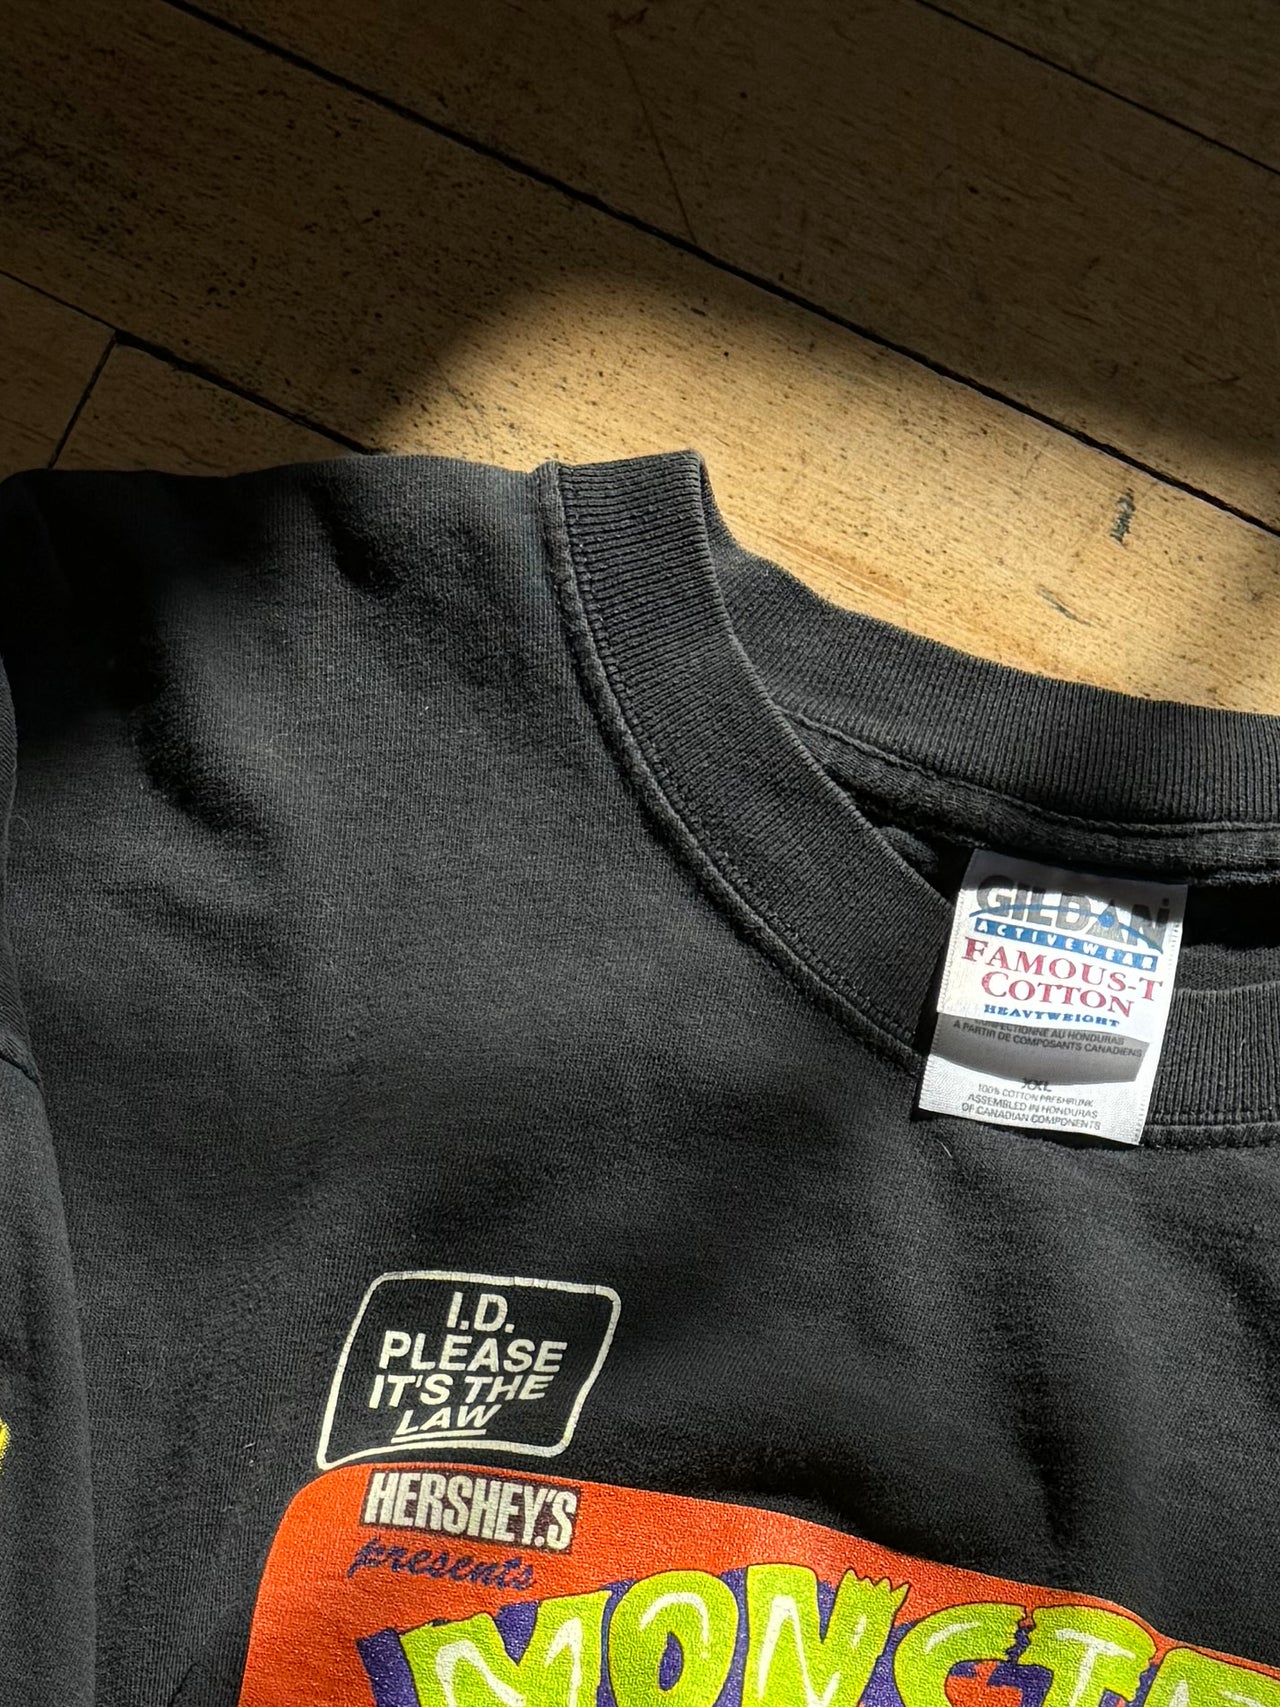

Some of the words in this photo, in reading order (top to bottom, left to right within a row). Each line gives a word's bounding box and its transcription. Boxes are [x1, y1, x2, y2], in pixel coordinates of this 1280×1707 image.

[974, 876, 1170, 953] GILDAN
[976, 920, 1154, 971] ACTIVEWEAR
[962, 936, 1164, 1001] FAMOUS-T
[981, 971, 1134, 1018] COTTON
[983, 1004, 1120, 1027] HEAVYWEIGHT
[998, 1031, 1013, 1044] DE
[1013, 1034, 1083, 1051] COMPOSANTS
[1084, 1043, 1143, 1058] CANADIENS
[969, 1093, 1027, 1111] ASSEMBLED
[1041, 1104, 1099, 1119] HONDURAS
[1001, 1087, 1038, 1102] COTTON
[976, 1105, 1030, 1122] CANADIAN
[1030, 1114, 1102, 1131] COMPONENTS
[446, 1291, 515, 1334] I.D.
[378, 1330, 568, 1374] PLEASE
[369, 1374, 454, 1409] IT'S
[462, 1374, 554, 1405] THE
[395, 1404, 502, 1435] LAW
[364, 1472, 577, 1551] HERSHEY'S
[347, 1537, 534, 1590] presents
